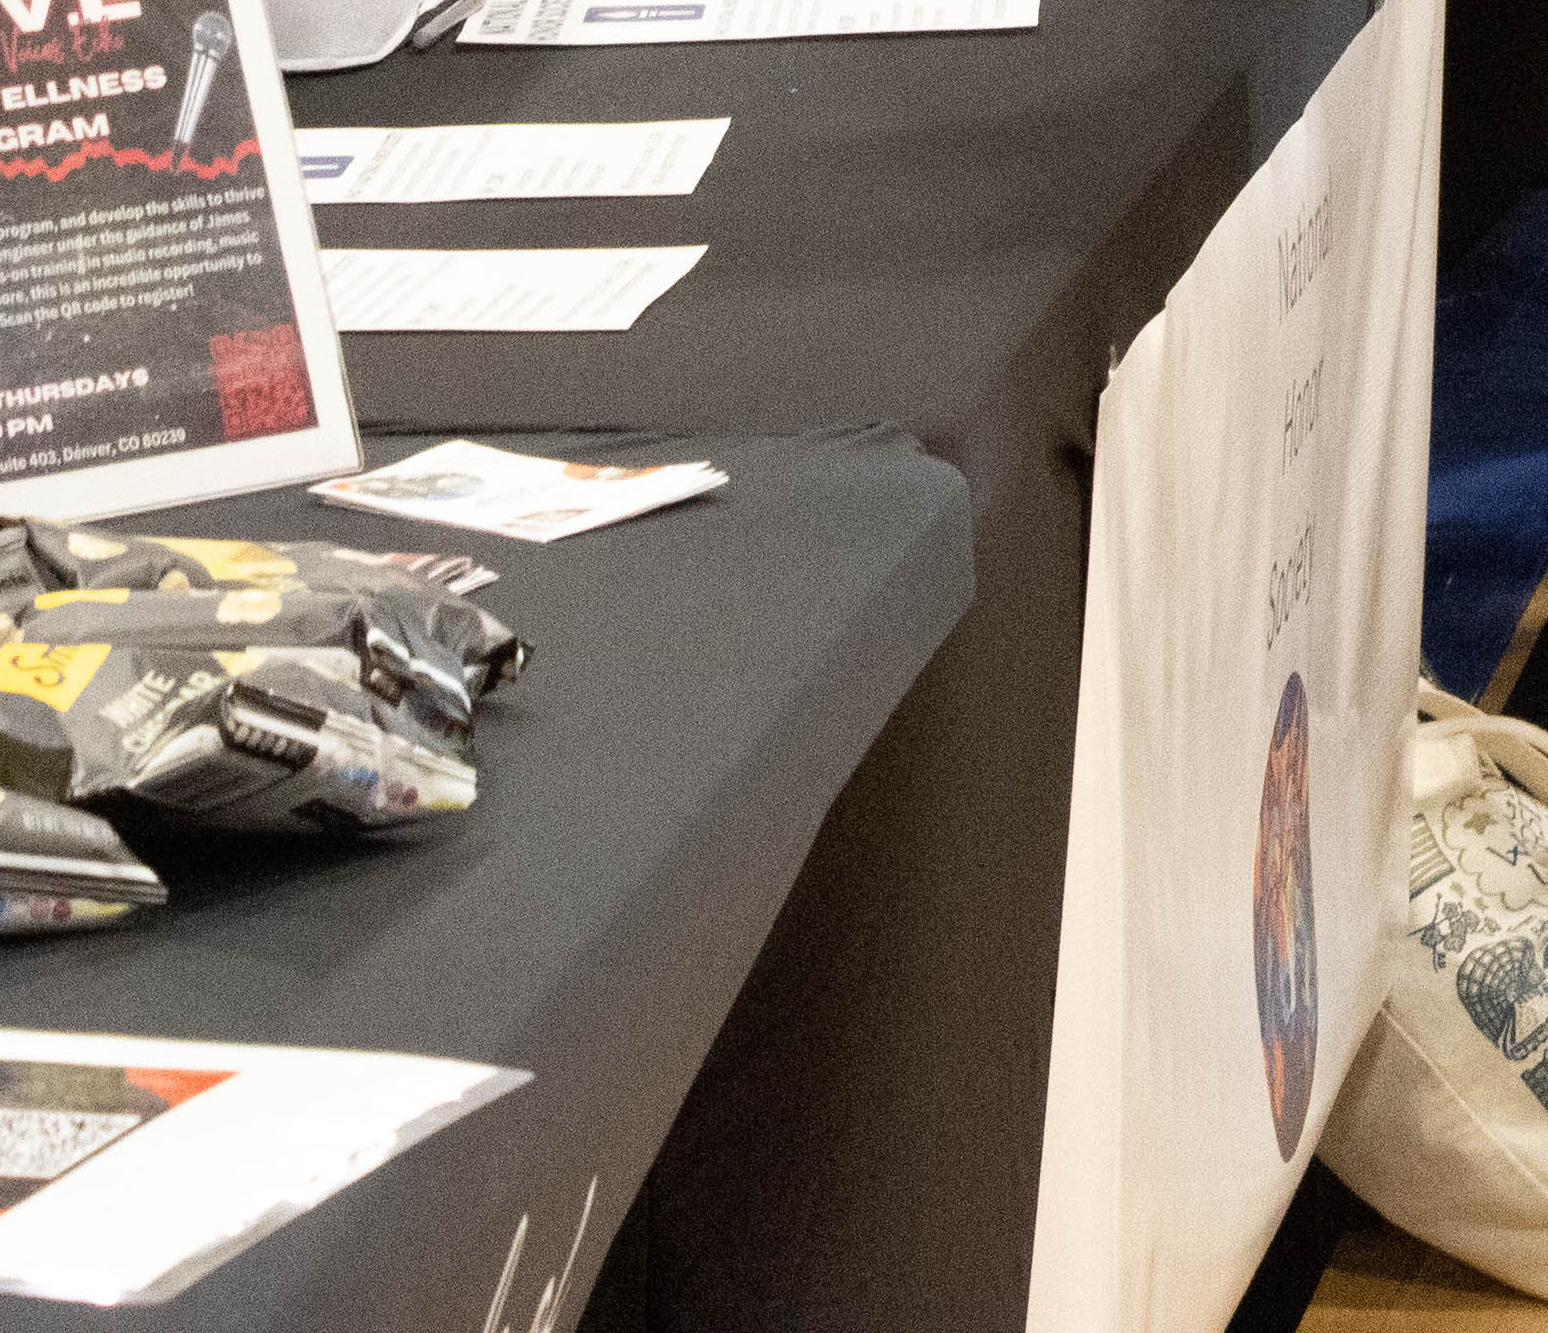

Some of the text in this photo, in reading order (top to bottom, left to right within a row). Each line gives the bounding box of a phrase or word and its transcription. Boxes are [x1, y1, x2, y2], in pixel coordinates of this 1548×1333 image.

[55, 232, 98, 252] under
[98, 228, 124, 246] the
[124, 218, 188, 245] guidance
[187, 215, 204, 232] of
[205, 208, 251, 232] James
[58, 211, 87, 230] and
[86, 202, 145, 228] develop
[144, 198, 169, 217] the
[170, 193, 205, 212] skills
[206, 190, 223, 207] to
[223, 183, 266, 204] thrive
[1278, 164, 1333, 326] National
[28, 283, 57, 301] this
[58, 281, 71, 296] is
[72, 281, 90, 294] an
[91, 267, 160, 291] incredible
[162, 254, 245, 283] opportunity
[245, 251, 263, 266] to
[33, 305, 59, 321] the
[59, 301, 83, 321] QR
[83, 295, 118, 313] code
[118, 292, 136, 308] to
[136, 283, 196, 309] register!
[6, 414, 54, 438] PM
[1282, 353, 1325, 476] Honor
[27, 449, 62, 470] 403,
[62, 439, 117, 464] Denver,
[117, 435, 140, 455] CO
[1265, 507, 1317, 651] Society
